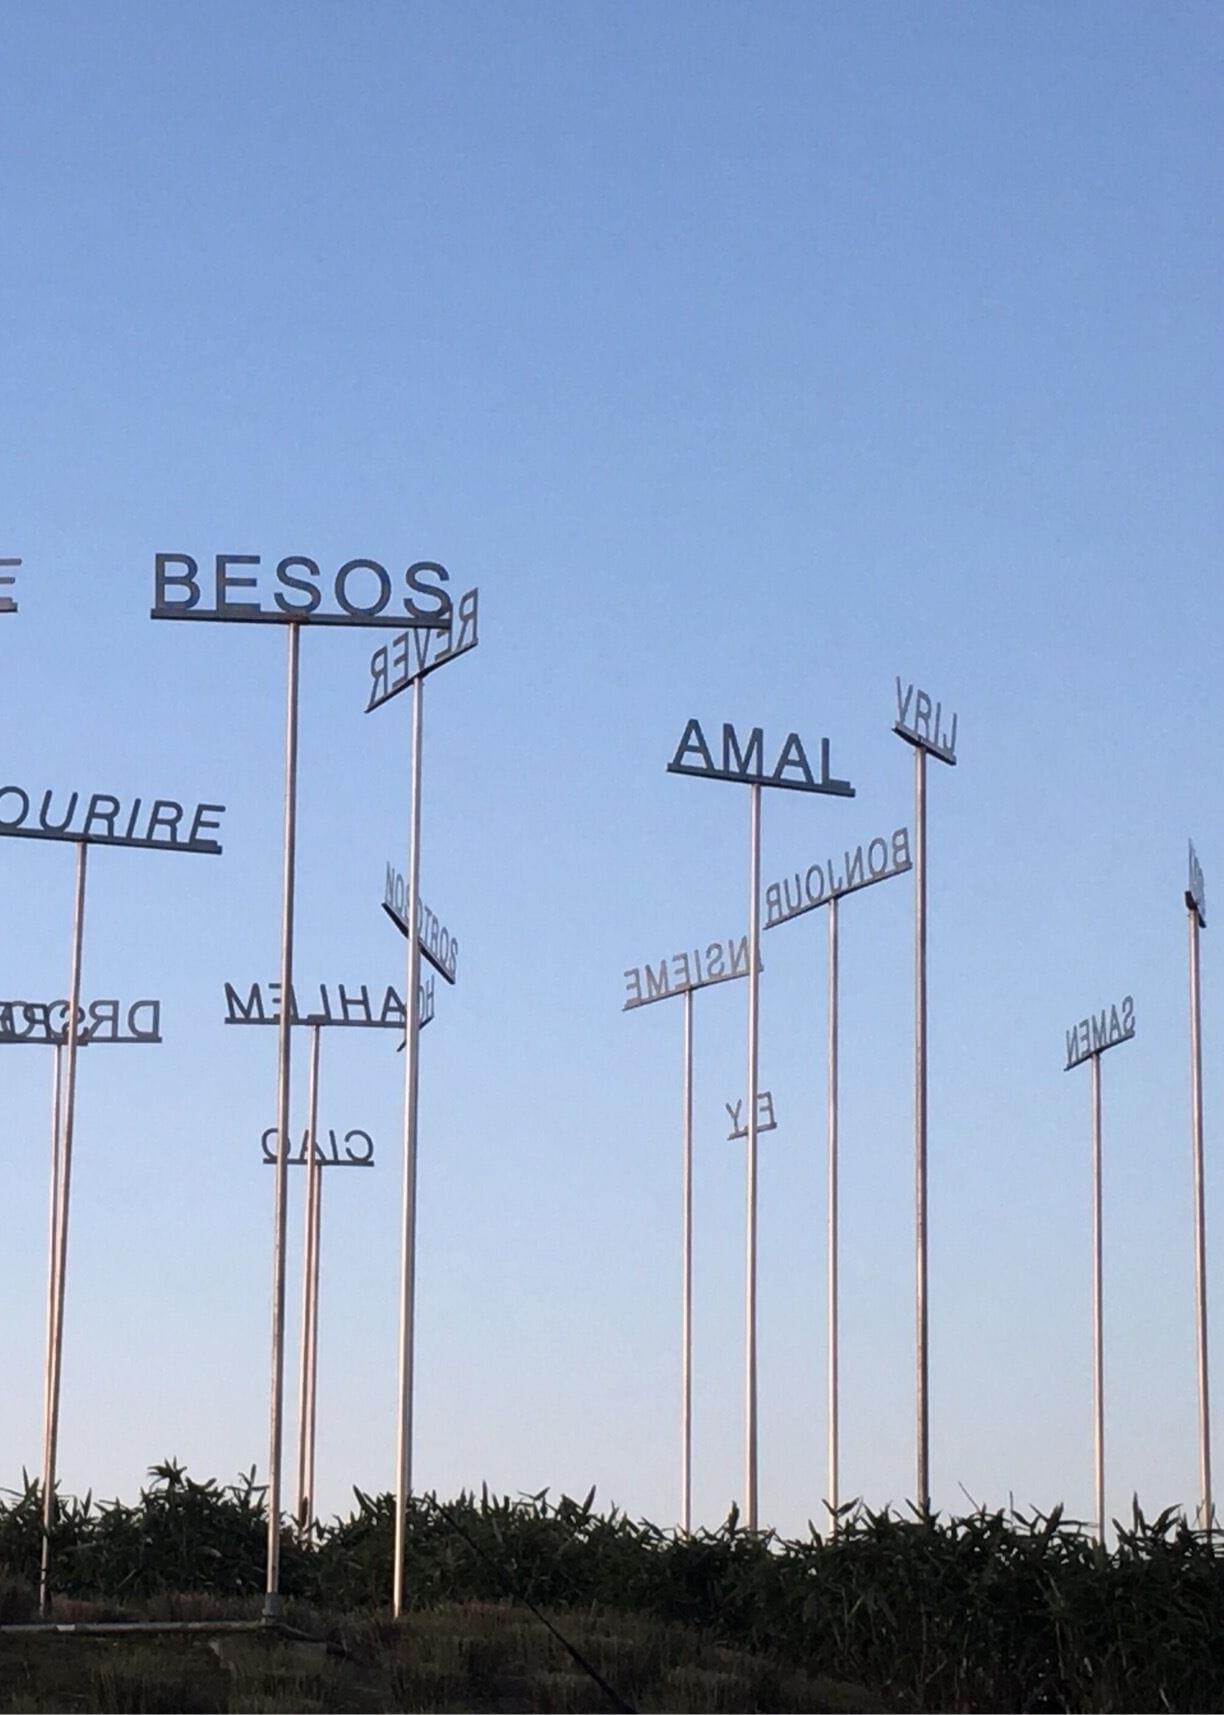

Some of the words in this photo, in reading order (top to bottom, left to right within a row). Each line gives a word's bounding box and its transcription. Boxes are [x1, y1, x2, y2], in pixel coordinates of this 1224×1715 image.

[154, 553, 450, 618] BESOS
[895, 676, 957, 757] VRIJ
[674, 719, 851, 788] AMAL
